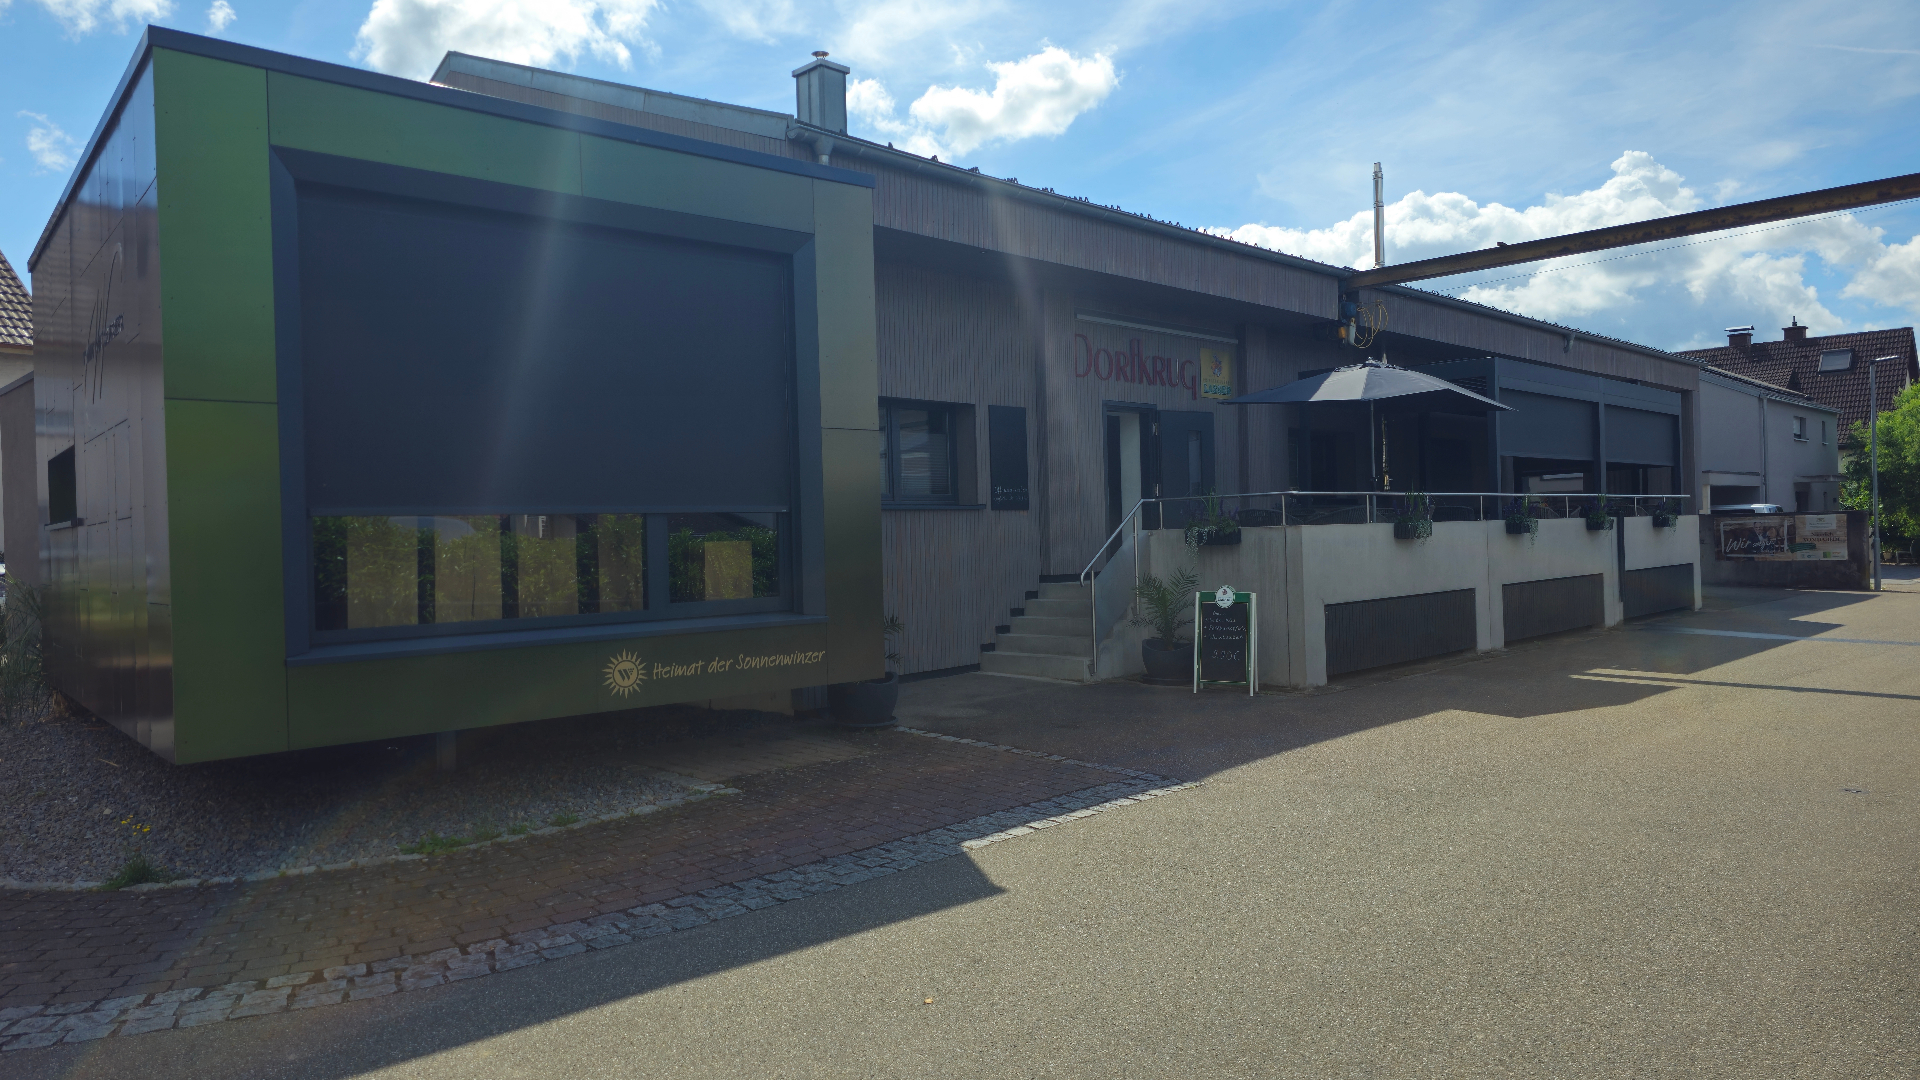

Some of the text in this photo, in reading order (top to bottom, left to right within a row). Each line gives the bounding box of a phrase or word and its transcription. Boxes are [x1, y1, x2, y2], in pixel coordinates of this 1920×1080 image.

[1725, 537, 1752, 553] Wir
[653, 650, 826, 680] Heimat der Sonnenwinzer
